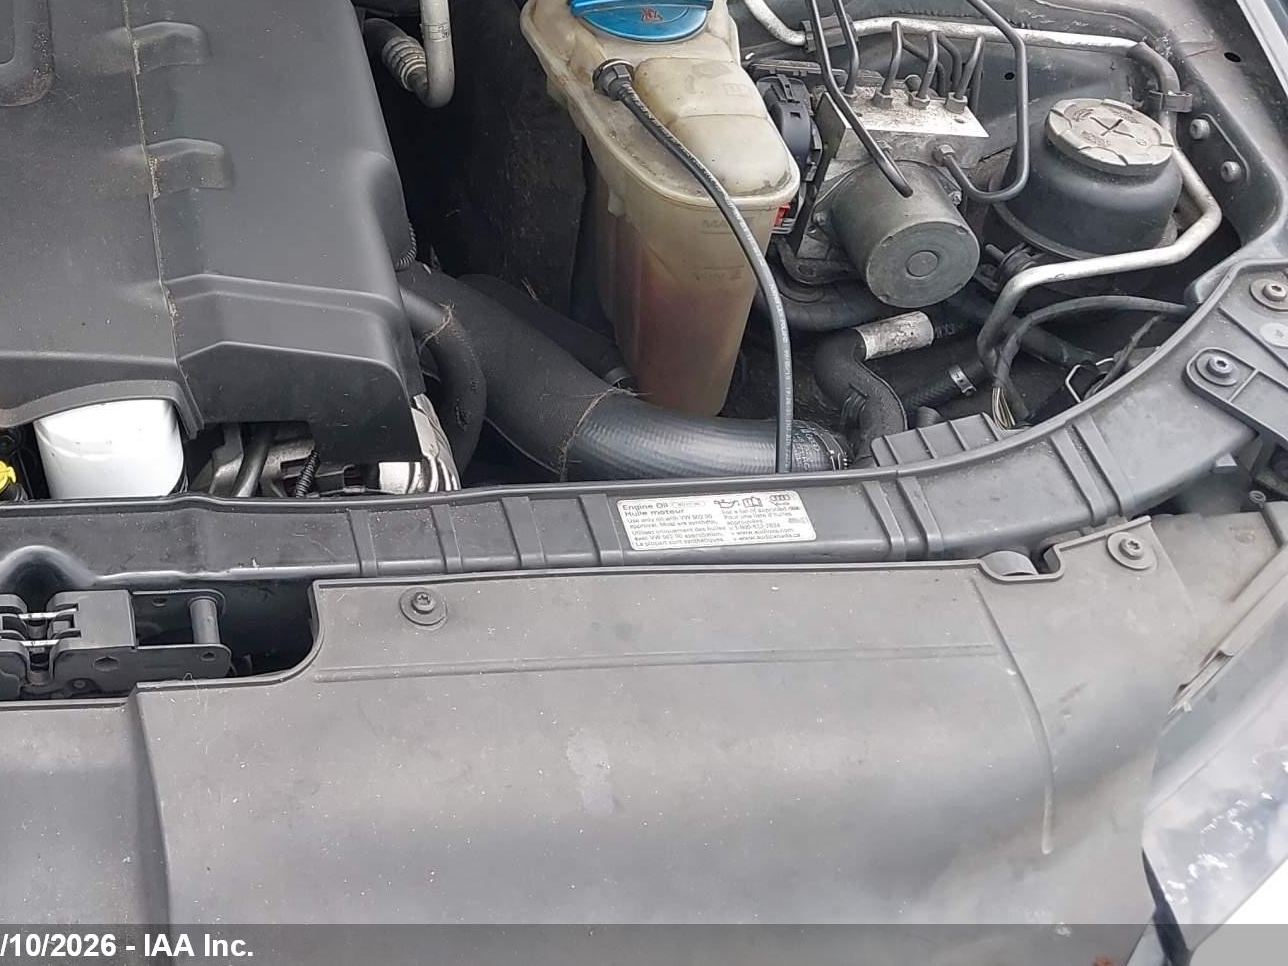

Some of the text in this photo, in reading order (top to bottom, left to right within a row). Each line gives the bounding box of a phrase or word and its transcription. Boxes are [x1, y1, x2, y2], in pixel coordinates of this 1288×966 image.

[622, 503, 654, 512] Engine
[655, 501, 670, 509] Oil
[650, 508, 685, 516] moteur
